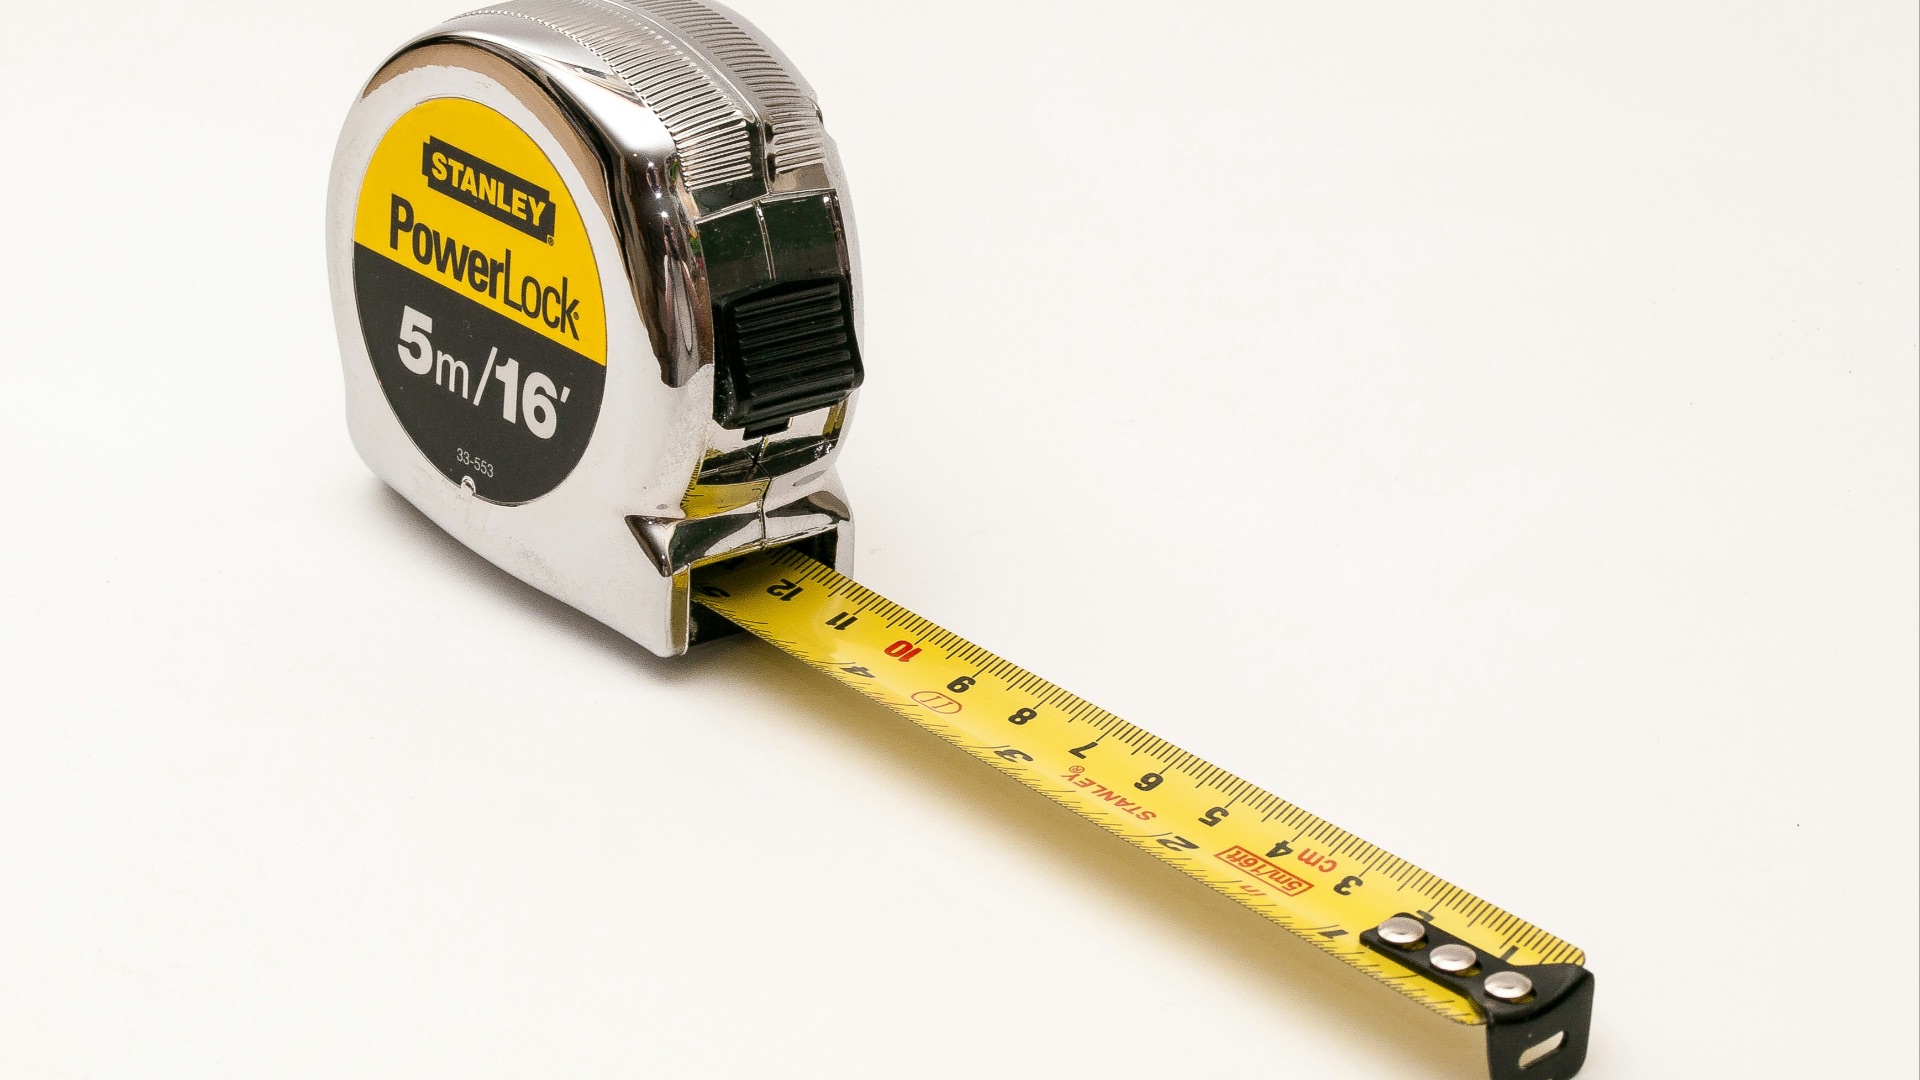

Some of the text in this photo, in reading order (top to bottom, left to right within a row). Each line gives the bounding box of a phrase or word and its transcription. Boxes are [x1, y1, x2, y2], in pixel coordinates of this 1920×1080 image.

[456, 447, 494, 478] 33-553
[766, 578, 804, 602] 12
[825, 611, 858, 631] 11
[884, 640, 923, 662] 10
[840, 664, 876, 678] 4
[946, 675, 977, 693] 9
[1008, 707, 1038, 725] 8
[994, 749, 1034, 763] 3
[1068, 741, 1099, 759] 7
[1133, 772, 1164, 792] 6
[1198, 806, 1230, 827] 5
[1156, 835, 1201, 852] 2
[1265, 839, 1294, 858] 4
[1297, 847, 1338, 873] cm
[1225, 849, 1303, 892] 5m/16ft
[1239, 884, 1268, 897] in
[1333, 875, 1364, 896] 3
[1317, 929, 1349, 939] 1
